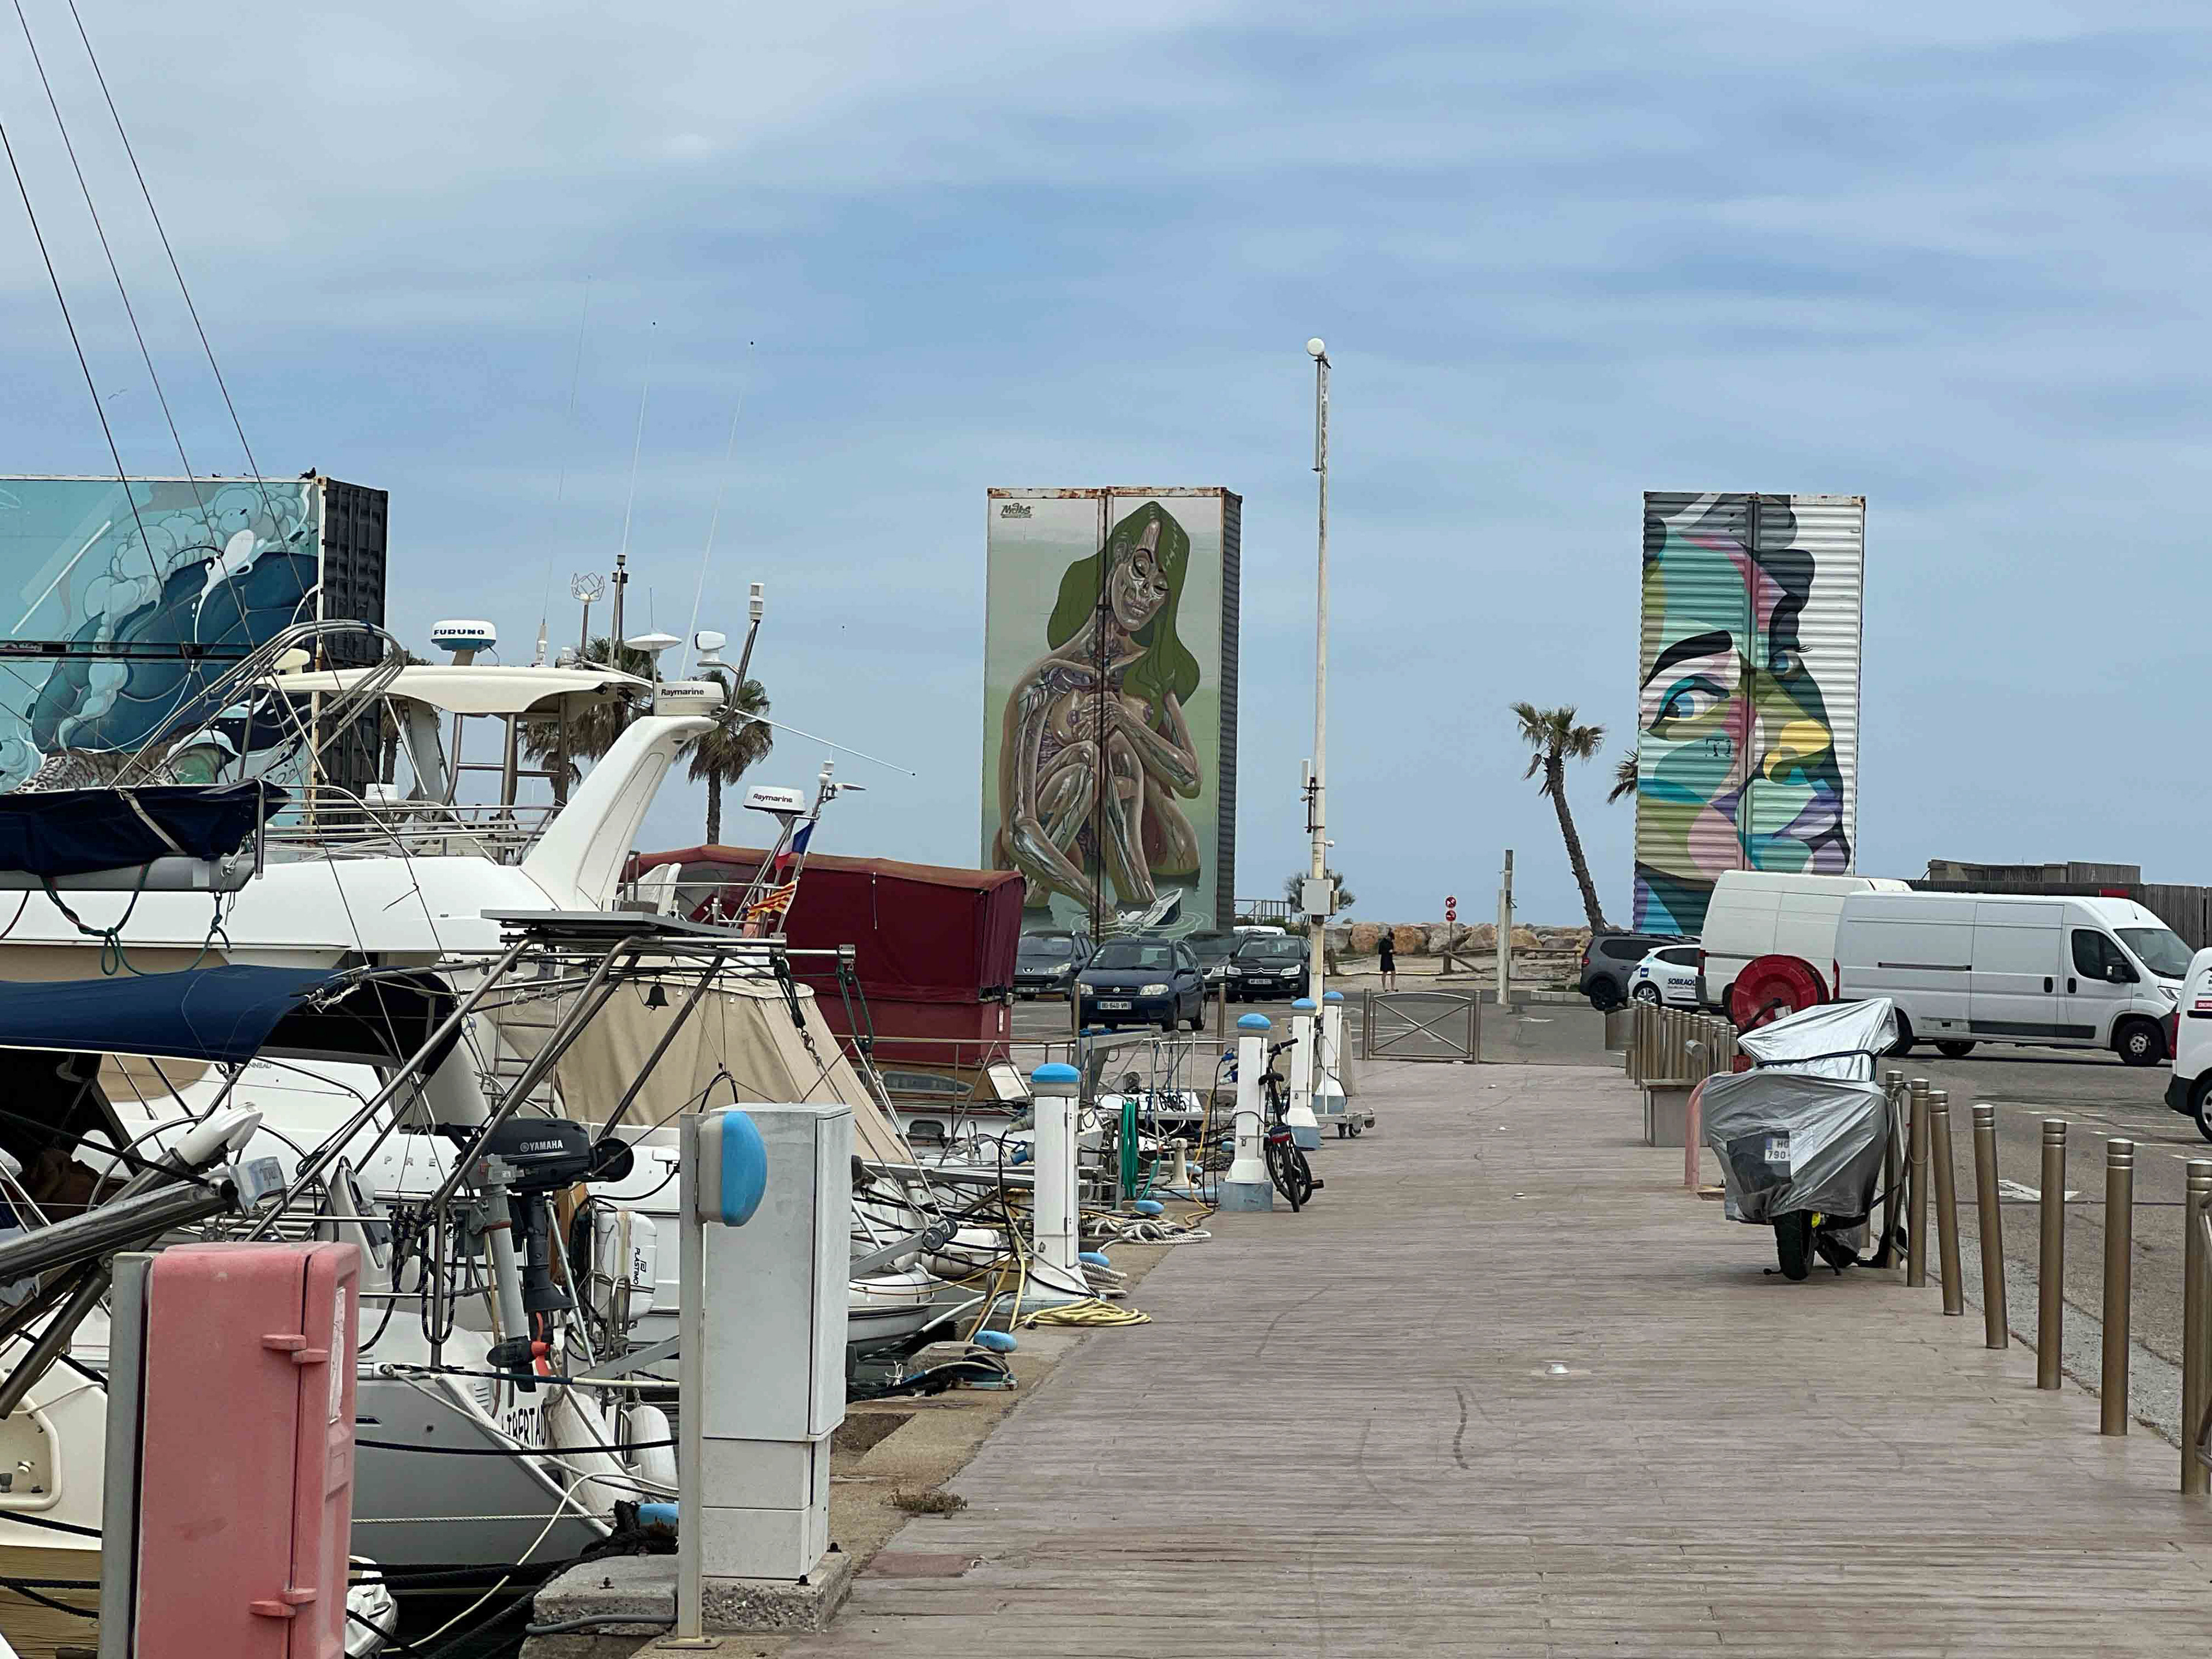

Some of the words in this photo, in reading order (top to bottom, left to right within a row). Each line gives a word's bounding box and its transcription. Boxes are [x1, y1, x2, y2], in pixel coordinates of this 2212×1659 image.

[661, 687, 704, 696] Raymarine
[752, 793, 793, 803] Raymarine
[530, 1140, 563, 1151] YAMAHA
